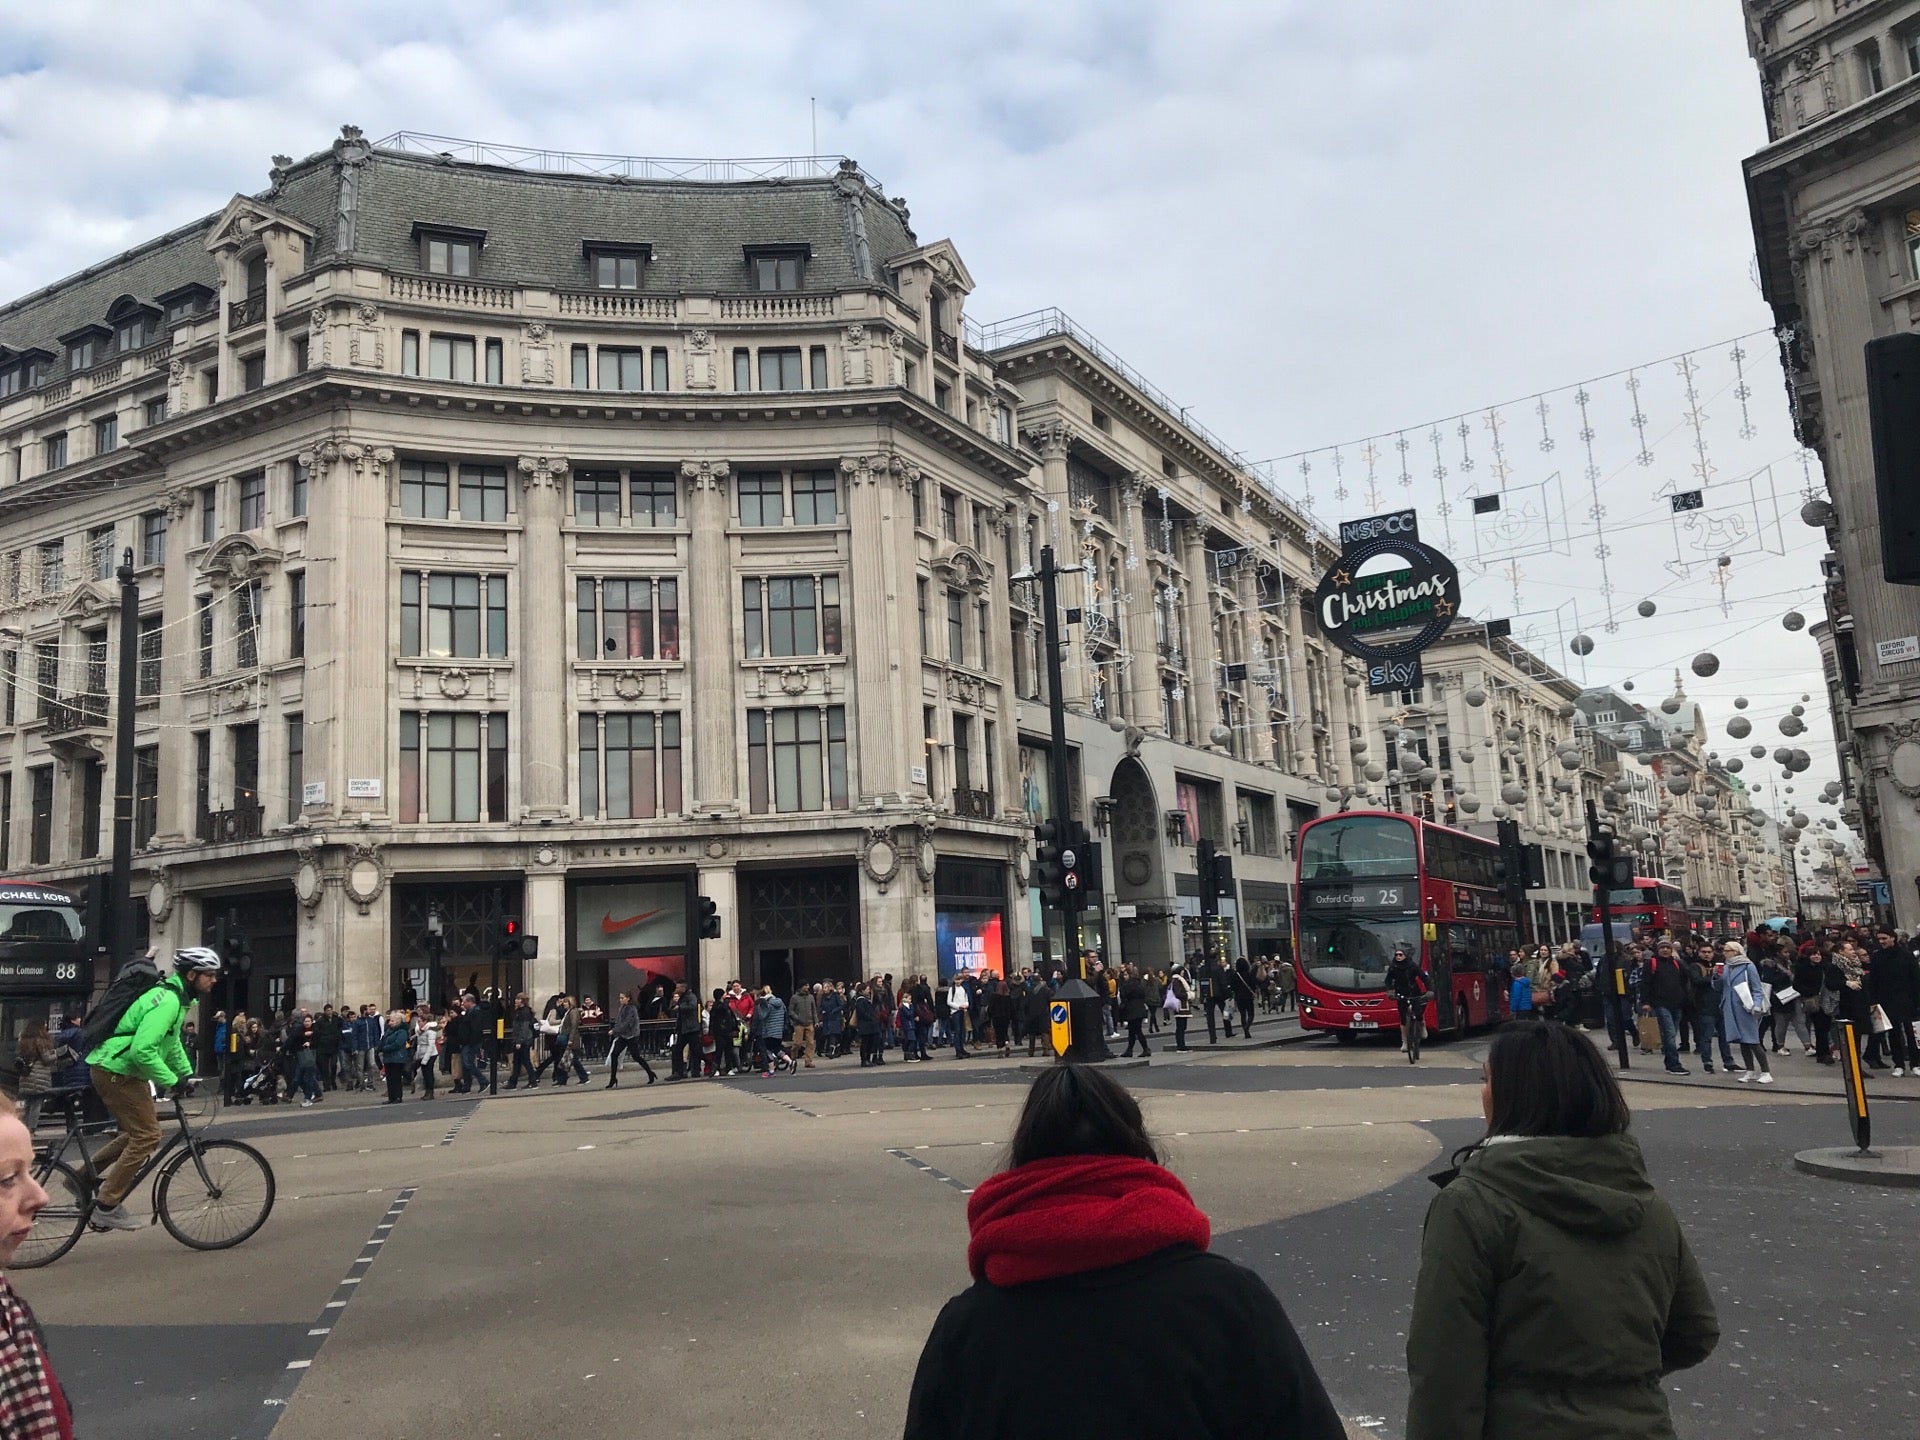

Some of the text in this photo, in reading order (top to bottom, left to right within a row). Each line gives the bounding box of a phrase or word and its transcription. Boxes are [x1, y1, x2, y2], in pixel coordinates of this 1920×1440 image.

[1673, 492, 1700, 510] 24
[1342, 513, 1415, 543] NSPCC
[1219, 551, 1237, 567] 20
[1357, 570, 1410, 591] LIGHT UP
[1322, 574, 1450, 629] Christmas
[1352, 600, 1431, 630] FOR CHILDREN
[1880, 640, 1905, 650] OXFORD
[1881, 648, 1905, 657] CIRCUS
[1370, 660, 1417, 686] sky
[576, 845, 687, 858] NIKETOWN
[0, 891, 71, 903] ICHAEL KORS
[1315, 889, 1398, 904] Oxford Circus 25
[955, 936, 984, 952] CHASE AWAY
[954, 953, 987, 970] THE WEATHER
[0, 962, 76, 979] ham Common 88
